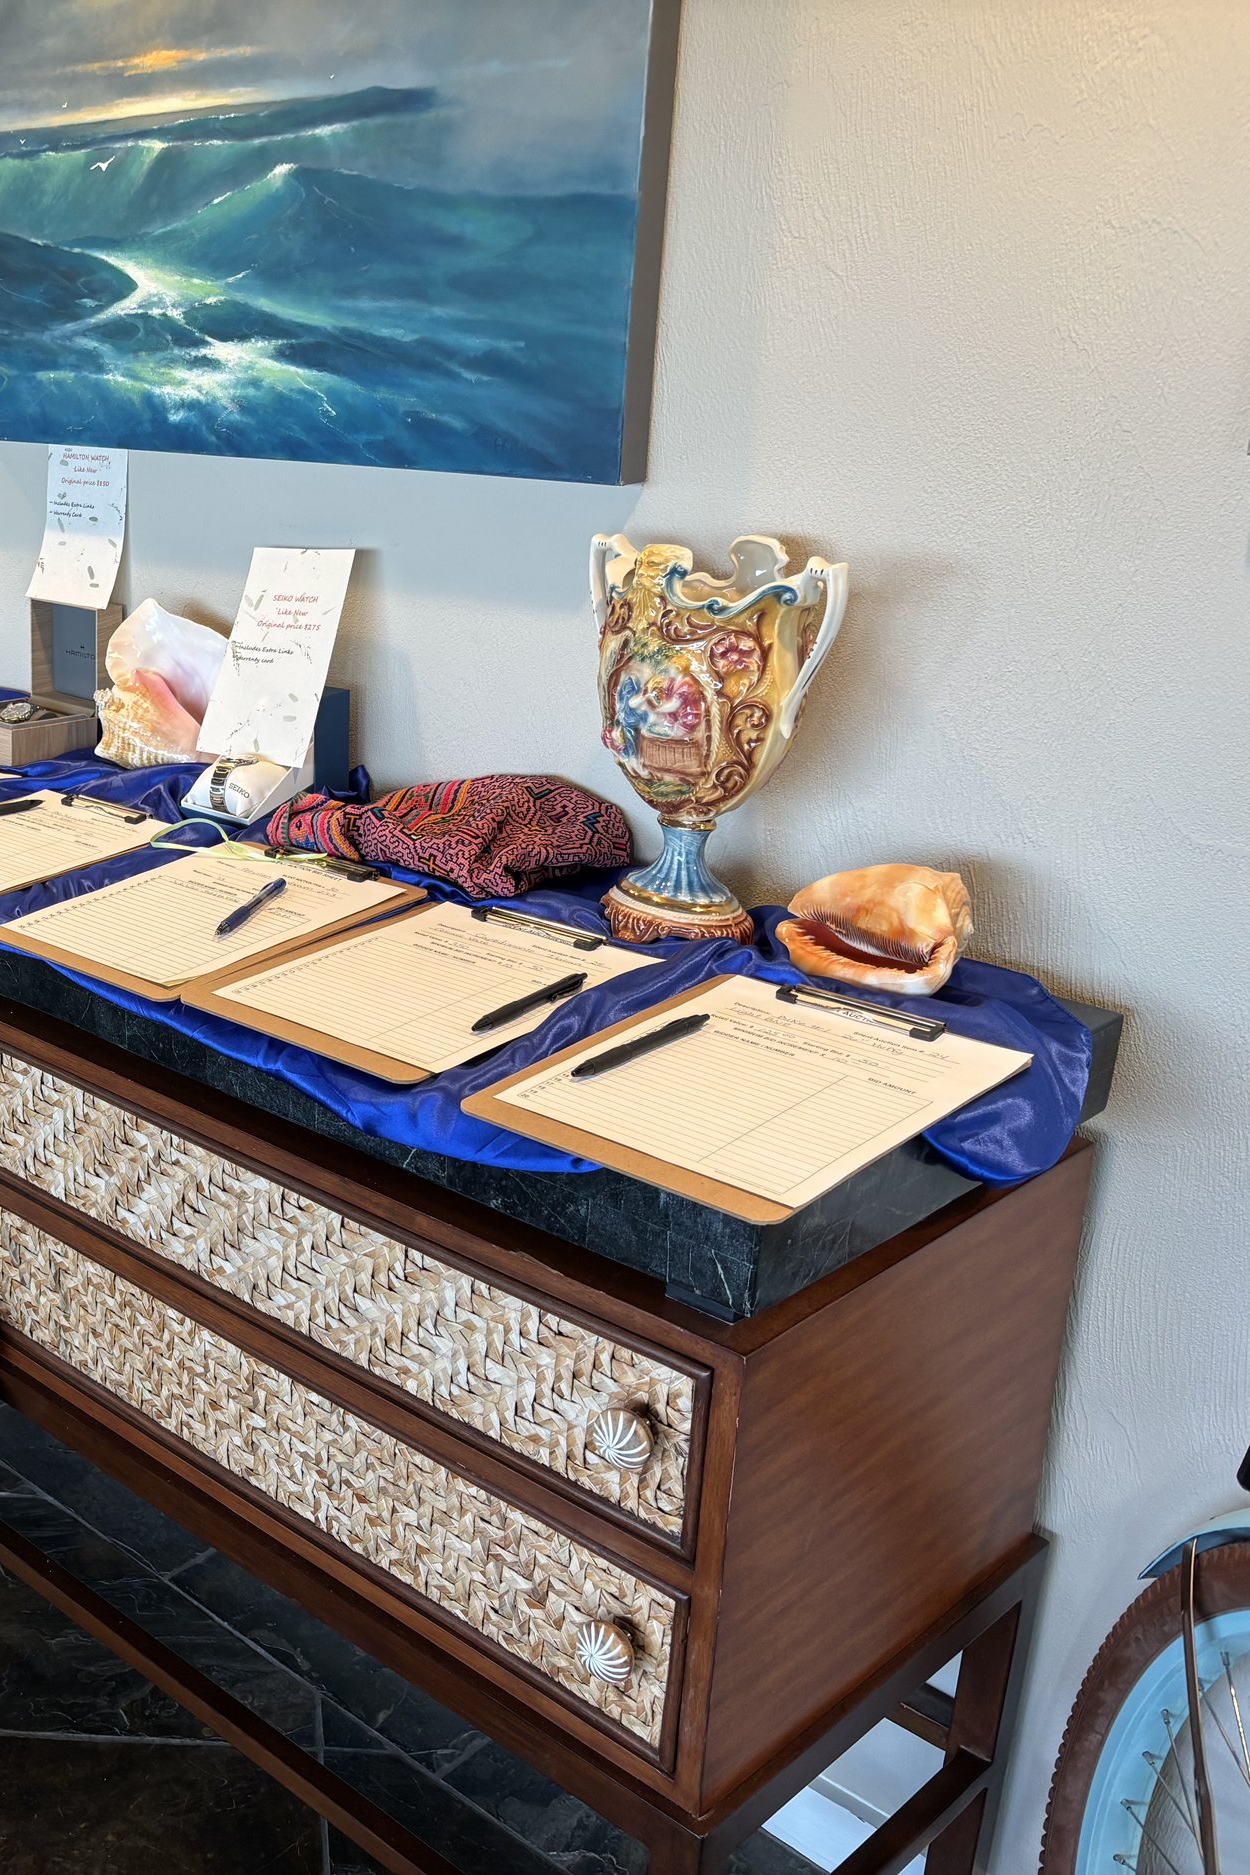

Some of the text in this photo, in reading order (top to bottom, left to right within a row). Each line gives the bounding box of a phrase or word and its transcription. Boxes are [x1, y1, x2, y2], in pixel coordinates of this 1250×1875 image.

[90, 454, 110, 462] WATCH
[61, 477, 82, 486] Original
[273, 594, 318, 603] SEIKO WATCH
[257, 620, 285, 629] Original
[304, 623, 321, 631] $275
[65, 650, 95, 660] HAMILTO
[228, 782, 250, 799] SEIKO
[883, 1081, 917, 1095] AMOUNT
